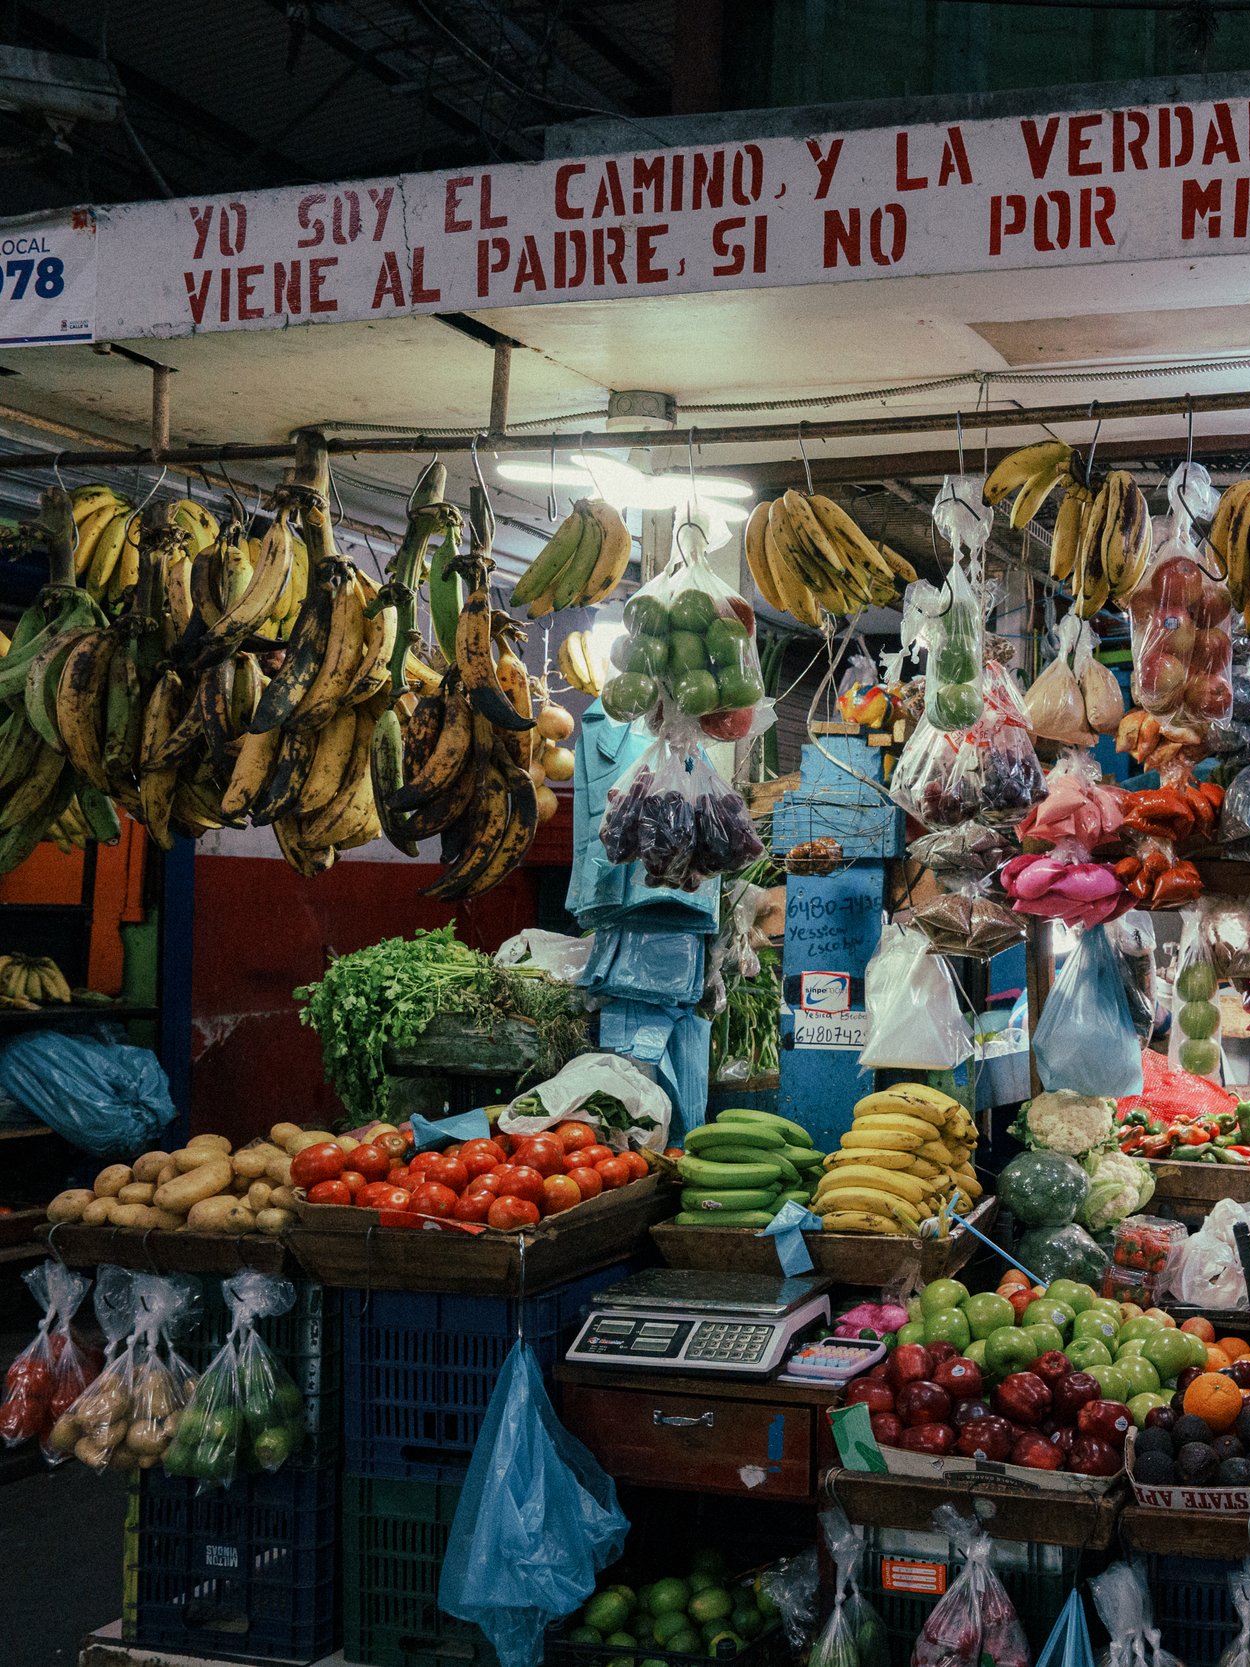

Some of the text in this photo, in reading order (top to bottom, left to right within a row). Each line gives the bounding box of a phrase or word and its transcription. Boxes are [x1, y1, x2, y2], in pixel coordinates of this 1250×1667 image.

[188, 202, 248, 260] YO
[298, 186, 395, 249] SOY
[444, 174, 508, 233] EL
[555, 144, 786, 220] CAMINO,
[806, 138, 844, 200] Y
[896, 126, 973, 191] LA
[0, 237, 50, 256] OCAL
[184, 256, 339, 325] VIENE
[372, 247, 441, 310] AL
[477, 223, 686, 297] PADRE,
[712, 215, 768, 277] SI
[823, 203, 908, 269] NO
[989, 186, 1117, 256] POR
[1181, 177, 1250, 241] MI
[0, 257, 65, 299] 78
[795, 1026, 866, 1045] 6480742
[1181, 1491, 1249, 1510] STATE
[206, 1544, 237, 1557] VINDAS
[206, 1555, 238, 1567] MILTON
